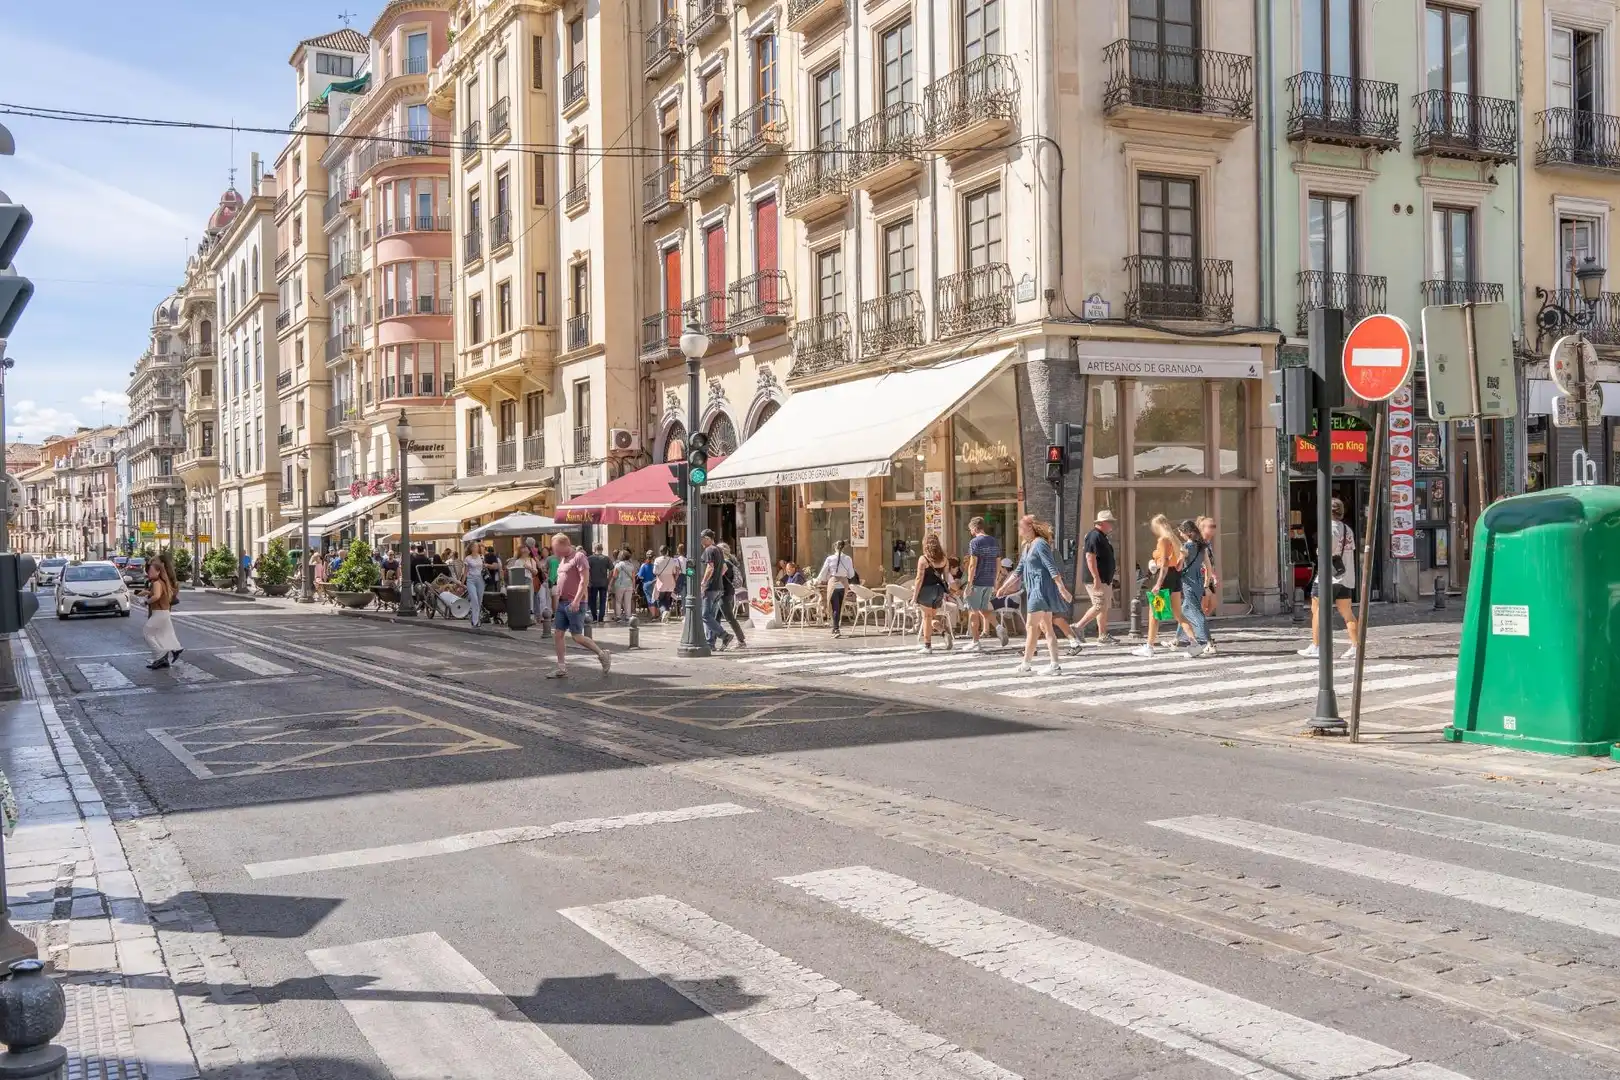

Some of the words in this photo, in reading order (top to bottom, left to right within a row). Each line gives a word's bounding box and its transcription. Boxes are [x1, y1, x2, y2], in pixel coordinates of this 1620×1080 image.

[1086, 361, 1142, 373] ARTESANOS
[1144, 363, 1156, 373] DE
[1158, 363, 1204, 374] GRANADA
[1299, 440, 1344, 450] Shama
[1345, 440, 1365, 453] King
[781, 471, 808, 483] ARTESANOS
[815, 467, 840, 479] GRANADA
